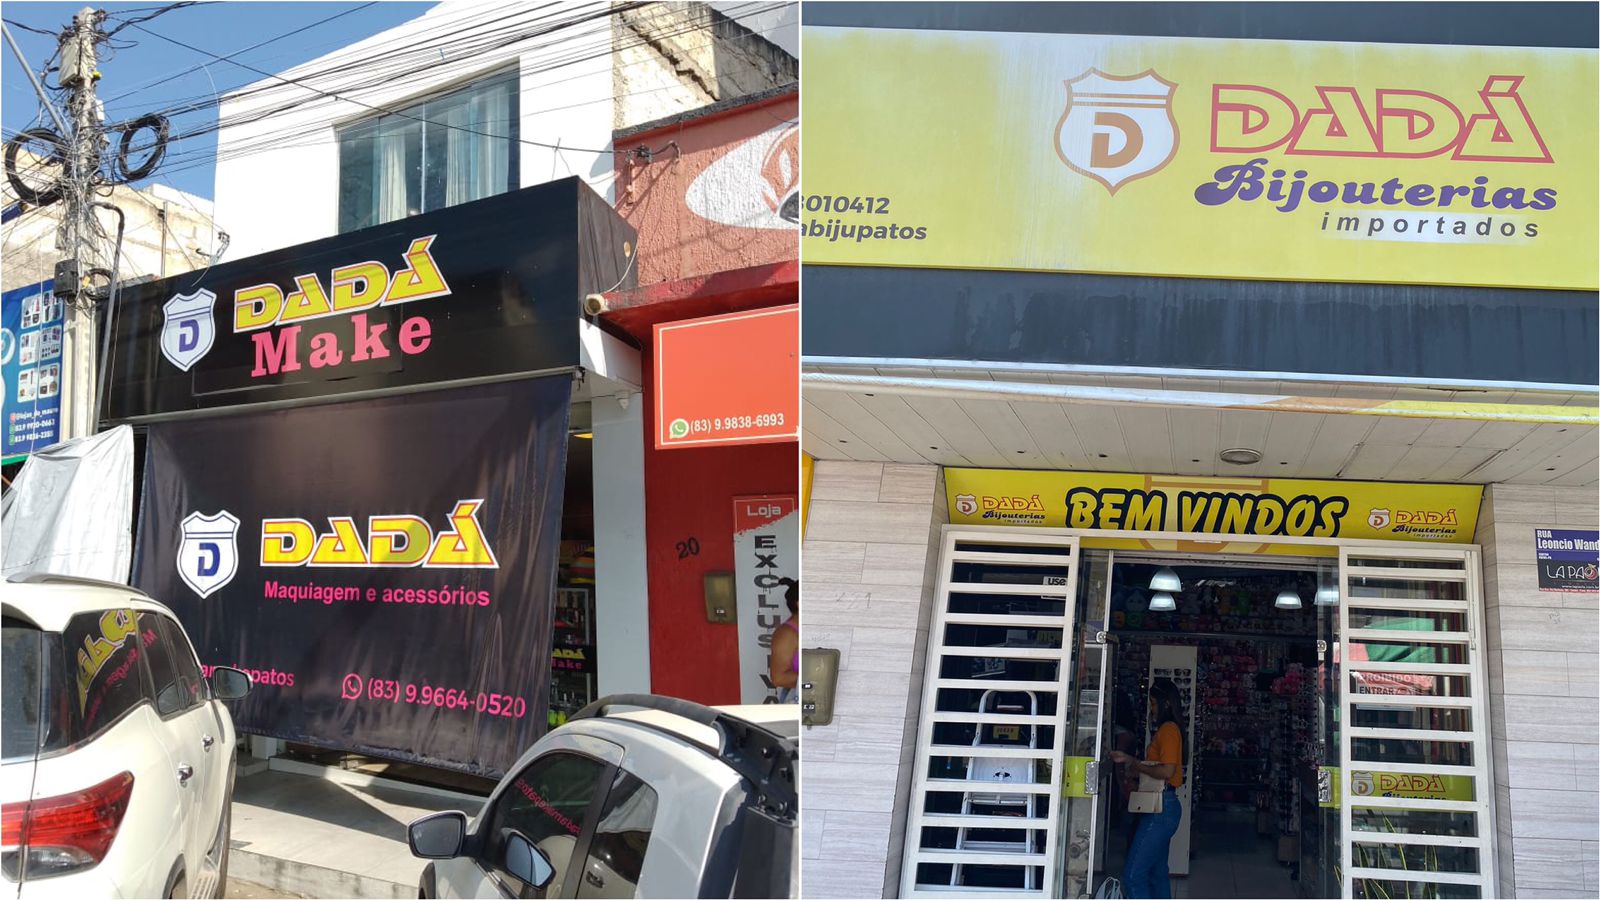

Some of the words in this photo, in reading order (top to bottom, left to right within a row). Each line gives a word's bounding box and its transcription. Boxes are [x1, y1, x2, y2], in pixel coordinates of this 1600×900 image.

[1210, 75, 1555, 164] DADÁ
[1090, 111, 1144, 169] D
[1194, 157, 1557, 213] Bijouterias
[1321, 211, 1540, 238] importados
[233, 234, 452, 333] DADÁ
[179, 320, 199, 352] D
[251, 315, 433, 377] Make
[690, 419, 711, 434] (83)
[714, 413, 784, 430] 9.9838-6993
[747, 504, 782, 518] Loja
[982, 494, 1046, 511] DADÁ
[982, 510, 1046, 520] Bijouterias
[1066, 487, 1167, 532] BEM
[1178, 492, 1349, 537] VINDOS
[1392, 523, 1457, 535] Bijouterias
[1396, 509, 1458, 525] DADÁ
[260, 499, 499, 568] DADÁ
[1537, 530, 1552, 538] RUA
[1538, 538, 1573, 550] Leoncio
[198, 542, 220, 577] D
[675, 536, 700, 561] 20
[264, 580, 360, 605] Maquiagem
[366, 588, 376, 602] e
[382, 585, 491, 607] acessórios
[1048, 577, 1067, 586] use
[367, 677, 400, 703] (83)
[405, 684, 526, 718] 9.9664-0520
